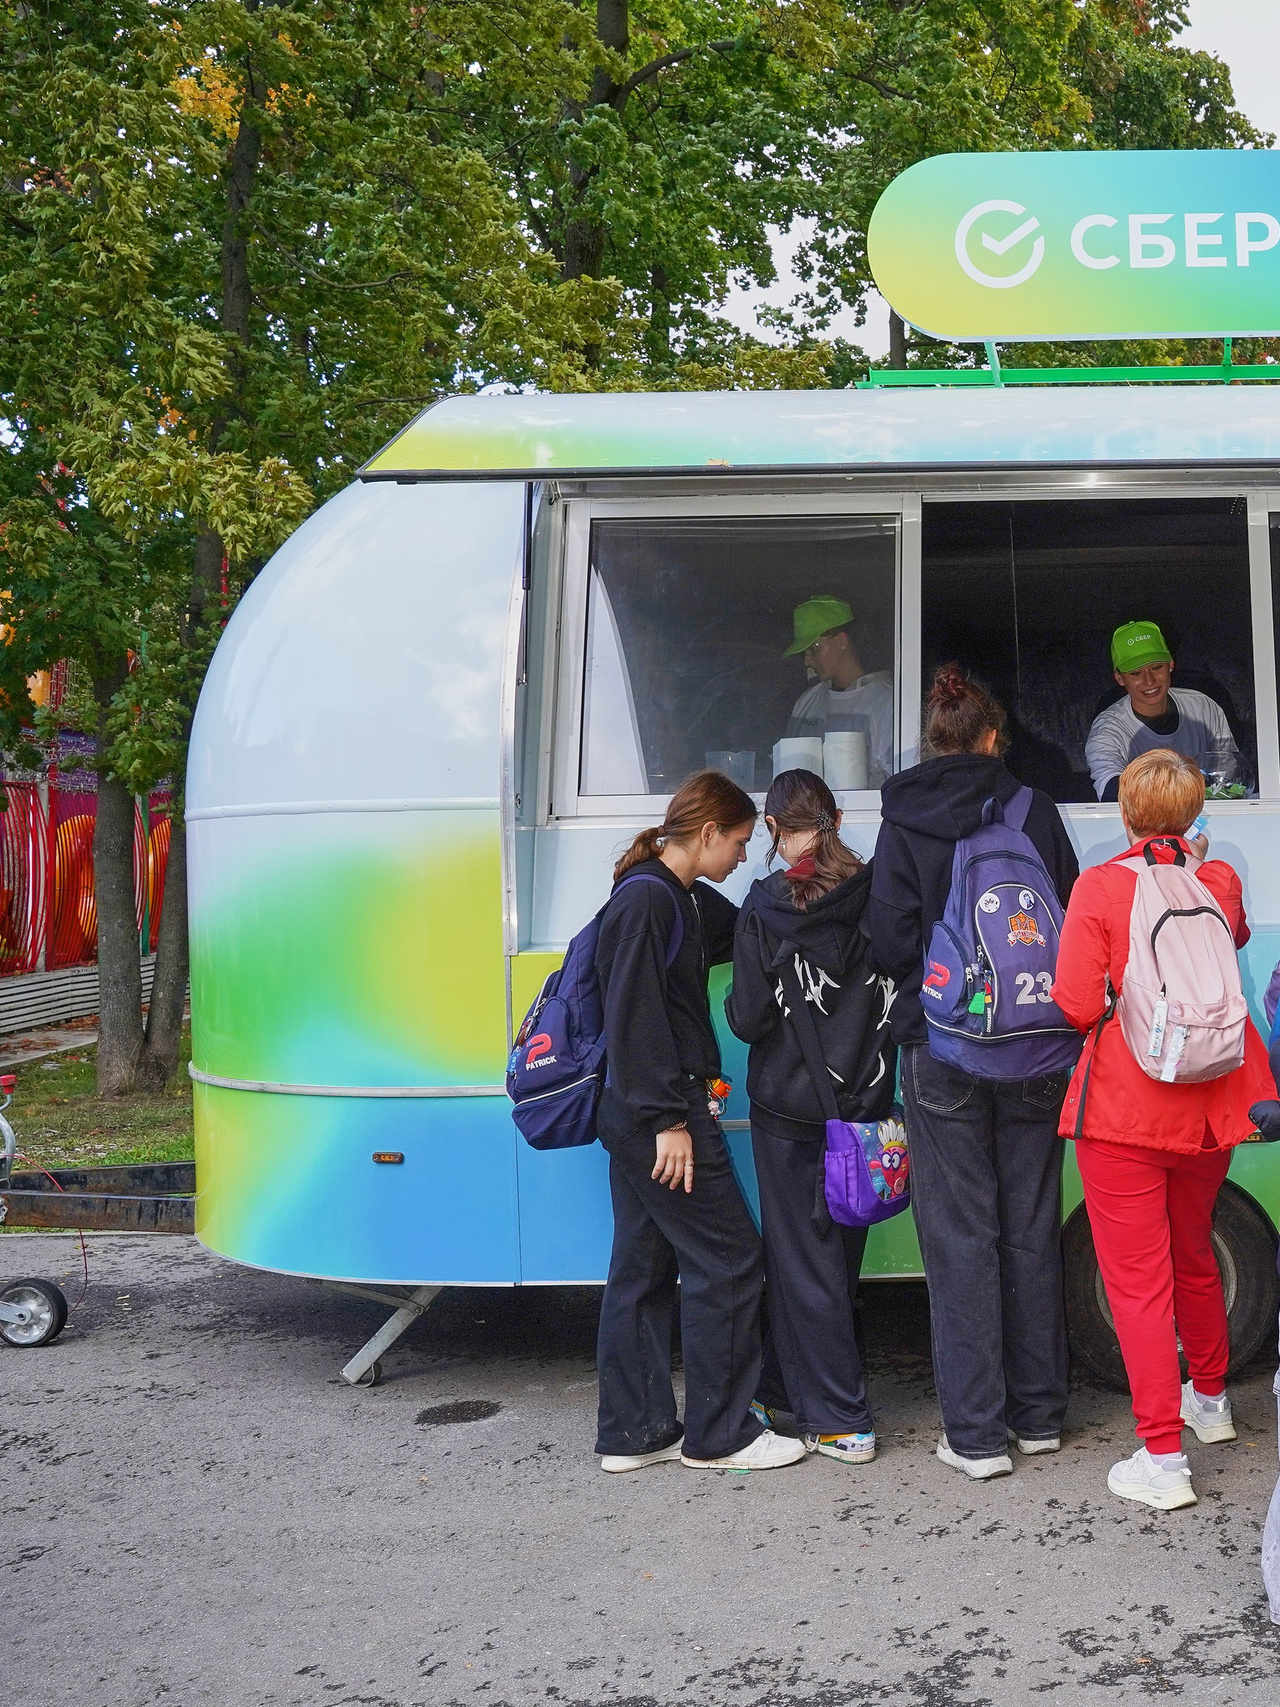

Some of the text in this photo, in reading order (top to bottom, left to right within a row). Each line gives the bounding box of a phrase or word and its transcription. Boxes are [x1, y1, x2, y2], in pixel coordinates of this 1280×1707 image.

[922, 984, 943, 1001] PATRICK
[1015, 971, 1054, 1005] 23
[525, 1055, 557, 1070] PATRICK
